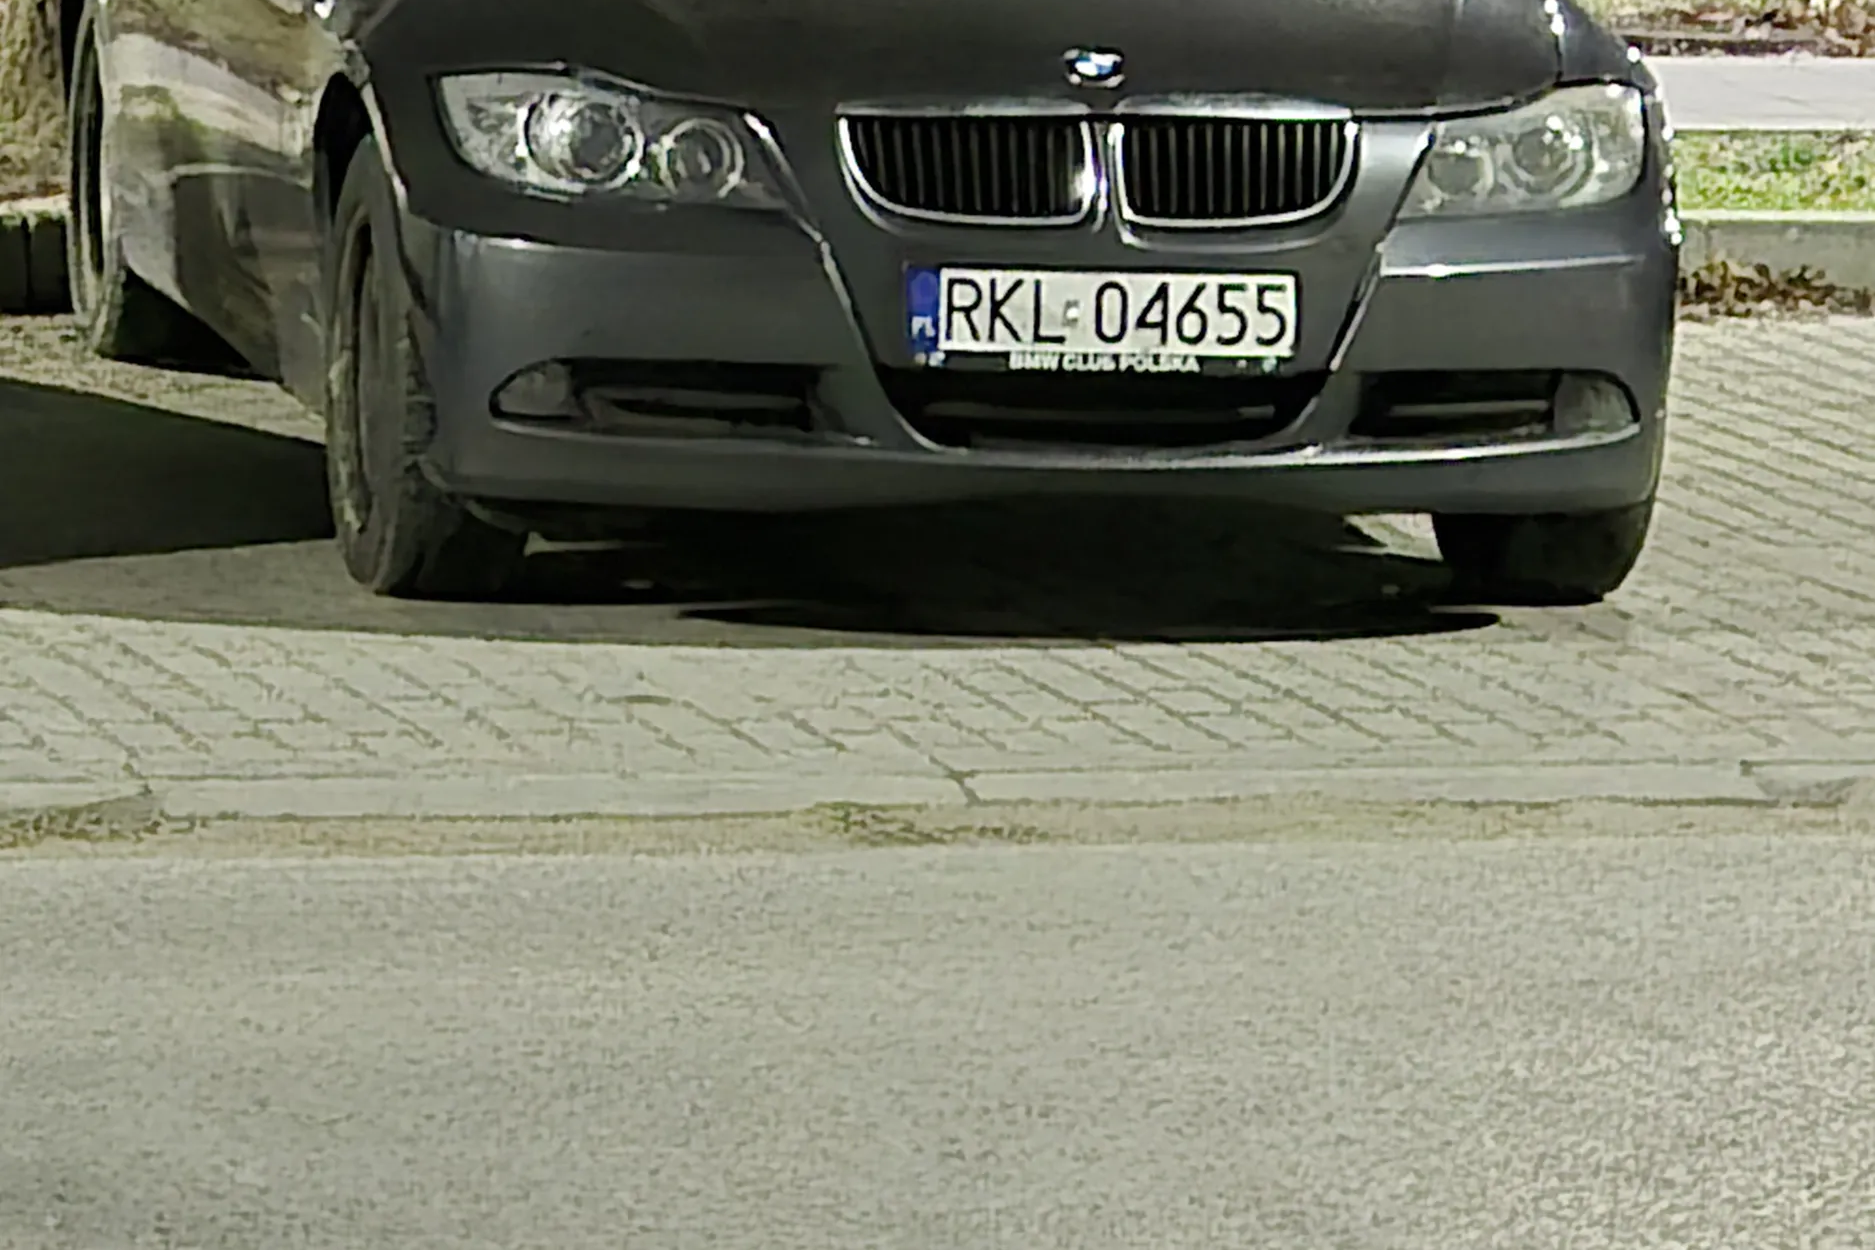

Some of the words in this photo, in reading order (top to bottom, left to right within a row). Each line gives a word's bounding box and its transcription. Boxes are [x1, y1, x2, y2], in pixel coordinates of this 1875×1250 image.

[946, 277, 1066, 343] RKL
[1095, 280, 1288, 347] 04655
[1009, 351, 1060, 371] BMW
